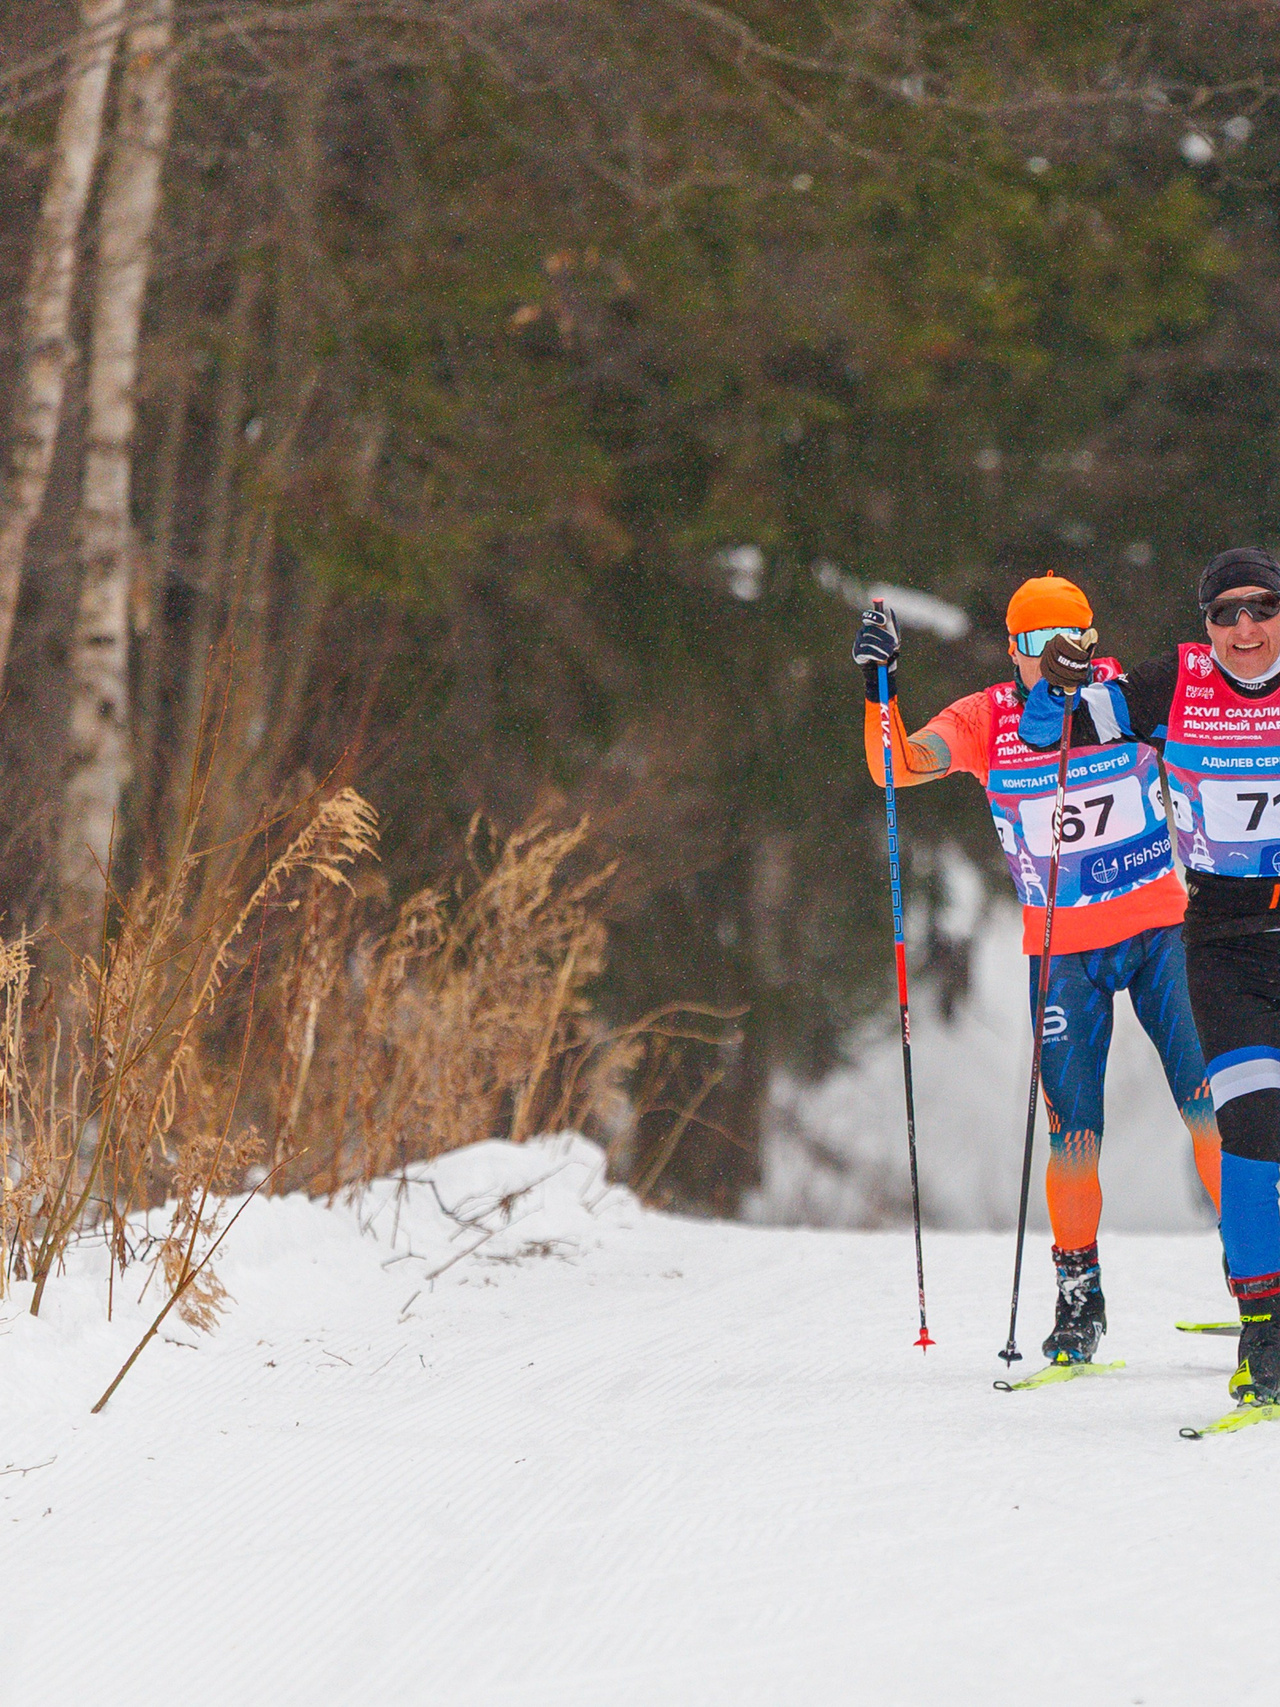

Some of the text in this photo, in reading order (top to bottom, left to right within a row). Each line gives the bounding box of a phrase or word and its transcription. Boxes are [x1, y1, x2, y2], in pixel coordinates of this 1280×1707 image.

[1183, 719, 1251, 731] ЛЫЖНЫЙ
[1089, 752, 1131, 774] СЕРГЕЙ
[1201, 756, 1254, 768] АДЫЛЕВ
[1052, 793, 1115, 843] 67
